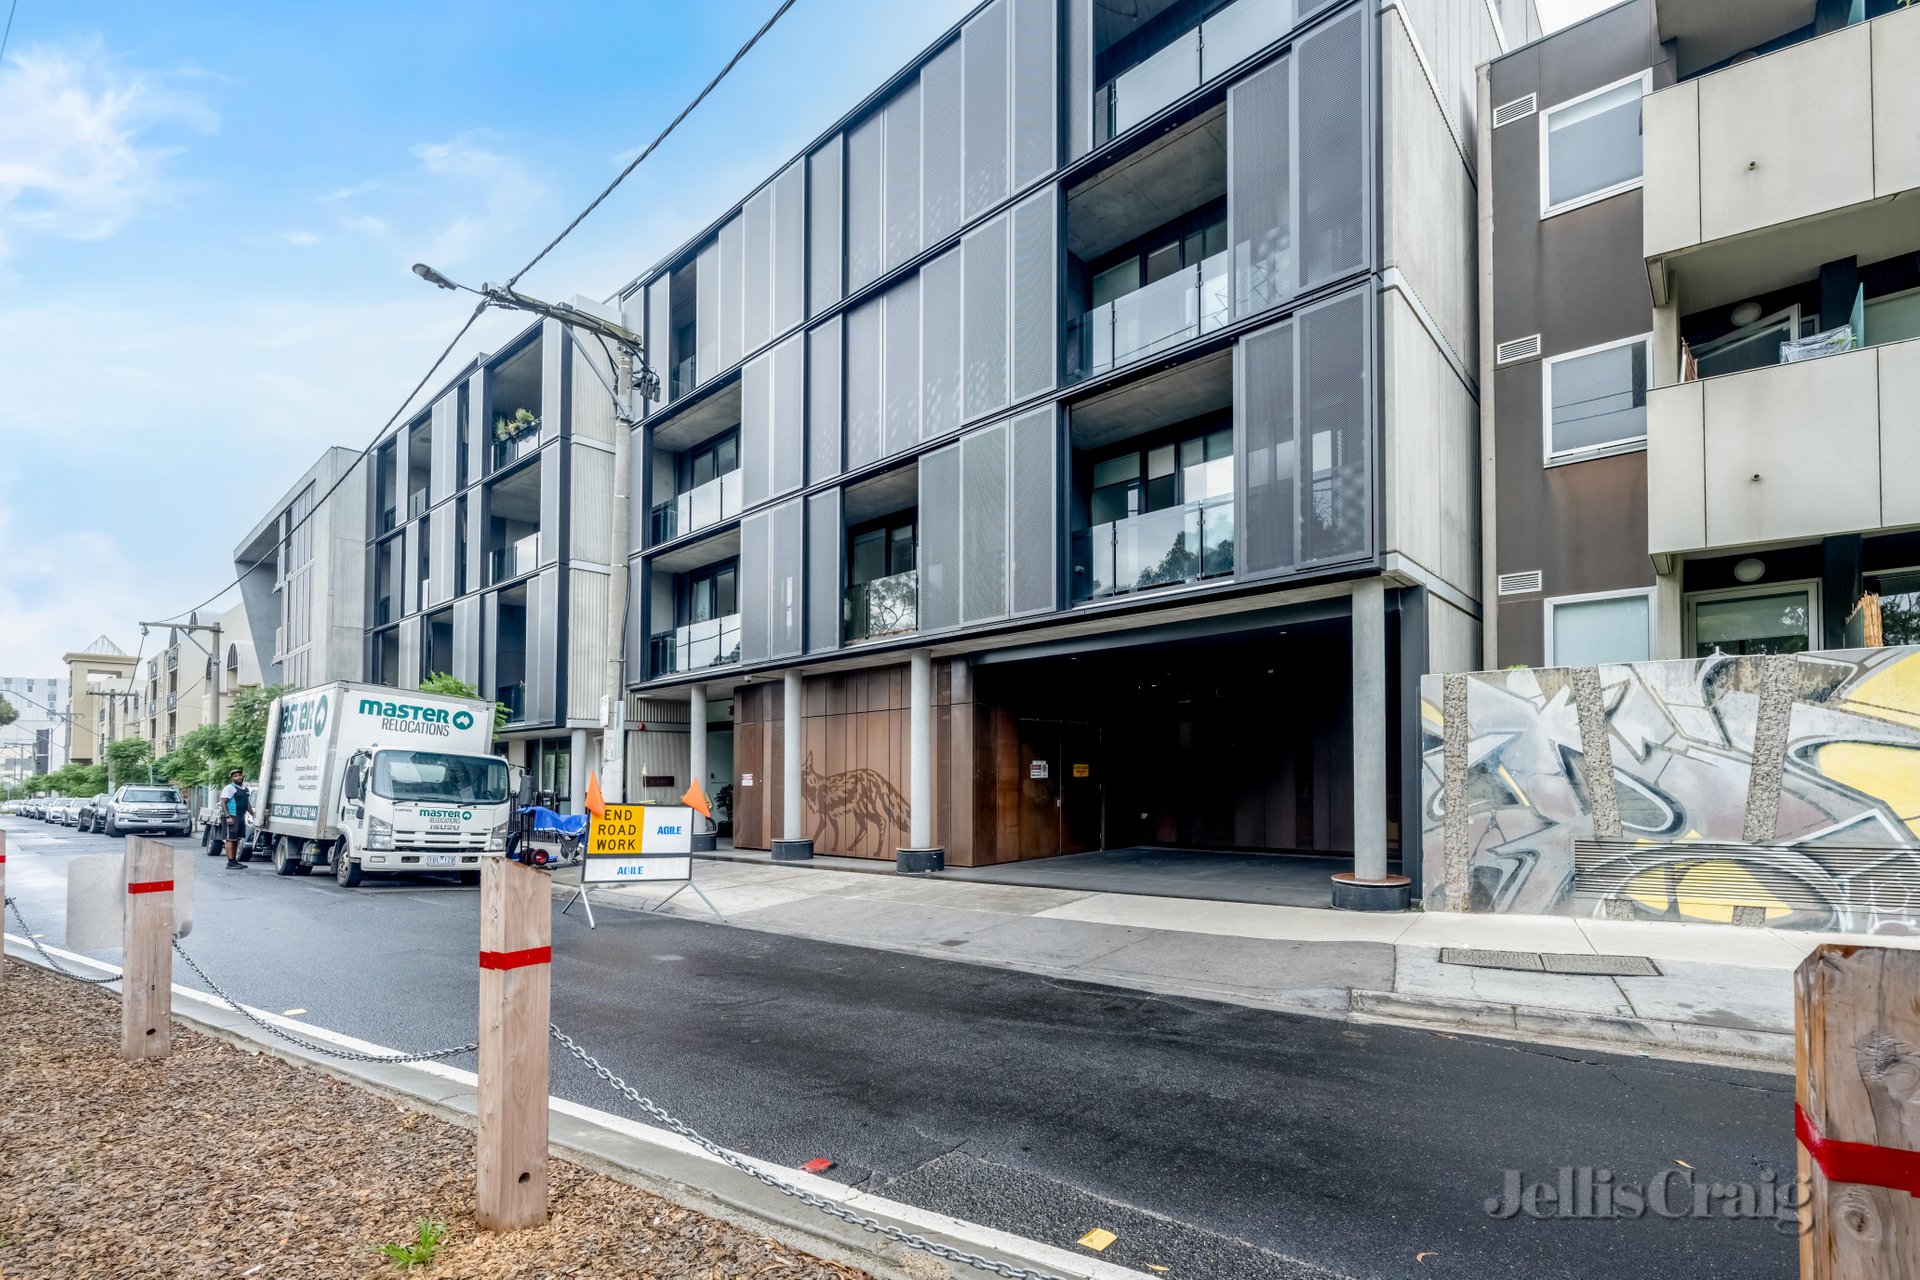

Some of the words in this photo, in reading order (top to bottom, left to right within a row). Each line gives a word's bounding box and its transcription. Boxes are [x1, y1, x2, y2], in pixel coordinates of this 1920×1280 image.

[381, 717, 450, 737] RELOCATIONS
[604, 809, 633, 821] END
[597, 824, 637, 836] ROAD
[656, 826, 682, 835] AGILE
[596, 839, 636, 851] WORK
